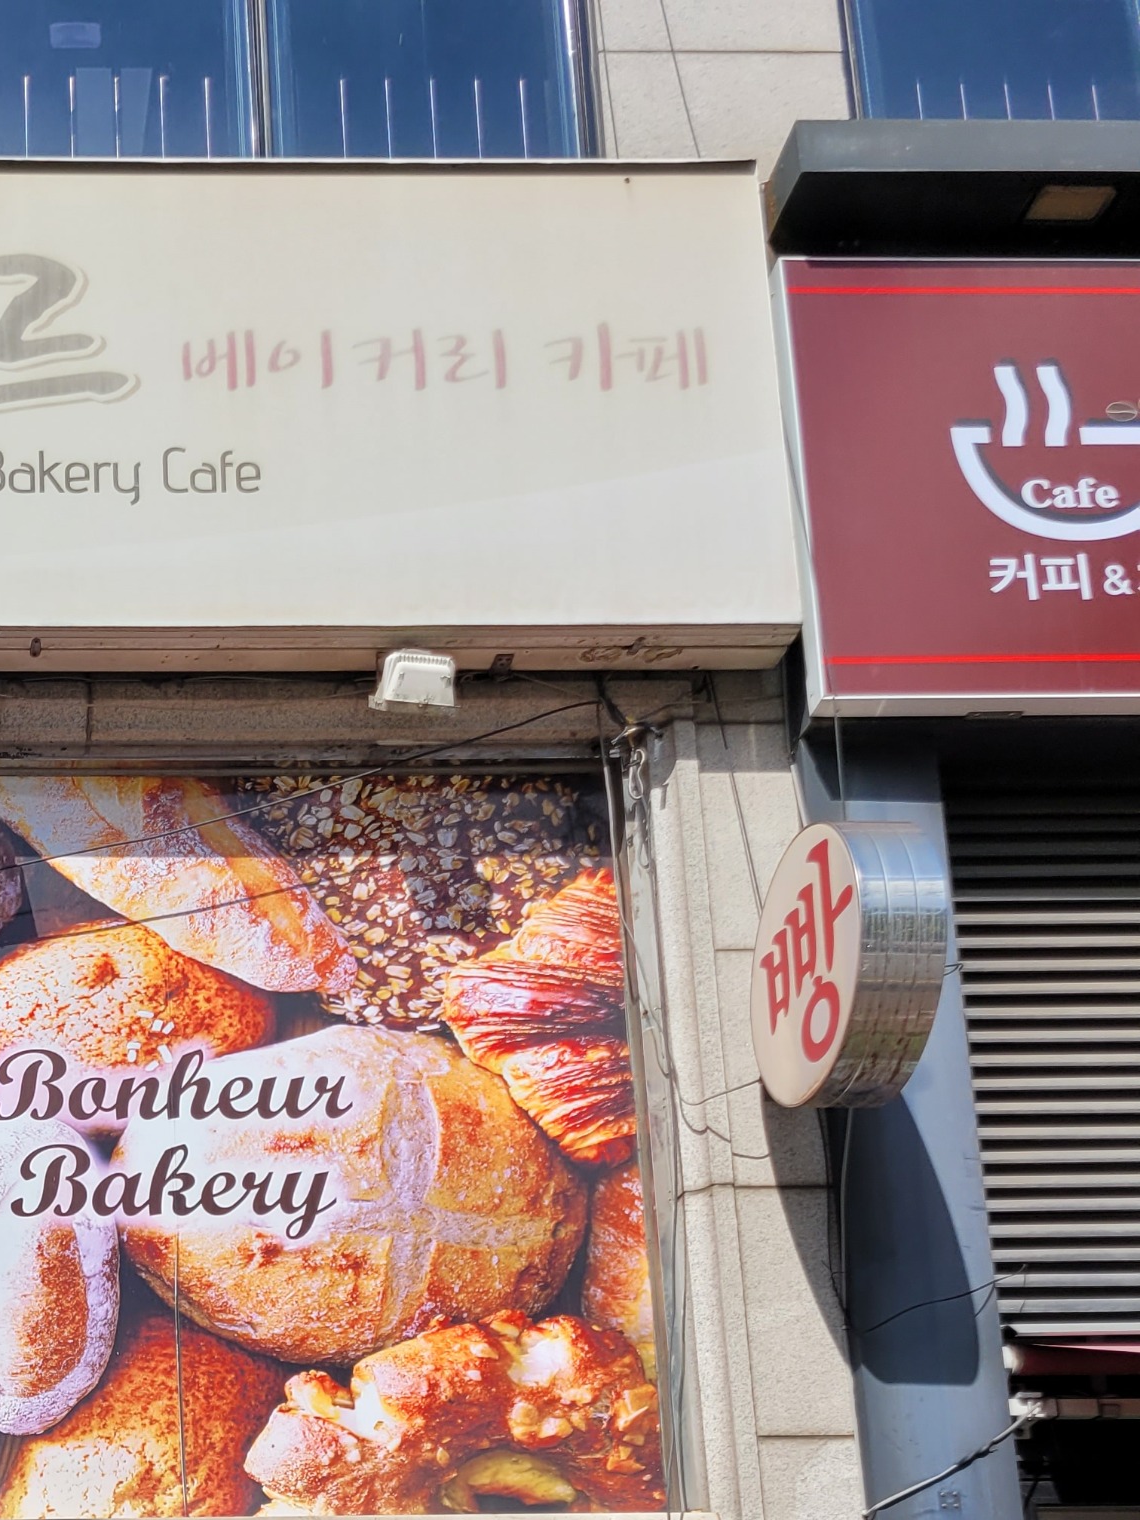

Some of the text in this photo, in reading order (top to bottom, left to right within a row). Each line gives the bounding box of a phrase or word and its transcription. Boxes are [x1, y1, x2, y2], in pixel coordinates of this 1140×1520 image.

[181, 321, 710, 392] 베이커리 카페
[161, 446, 262, 495] Cafe
[1020, 478, 1120, 510] Cafe
[759, 838, 853, 1063] 빵
[10, 1143, 337, 1240] Bakery
